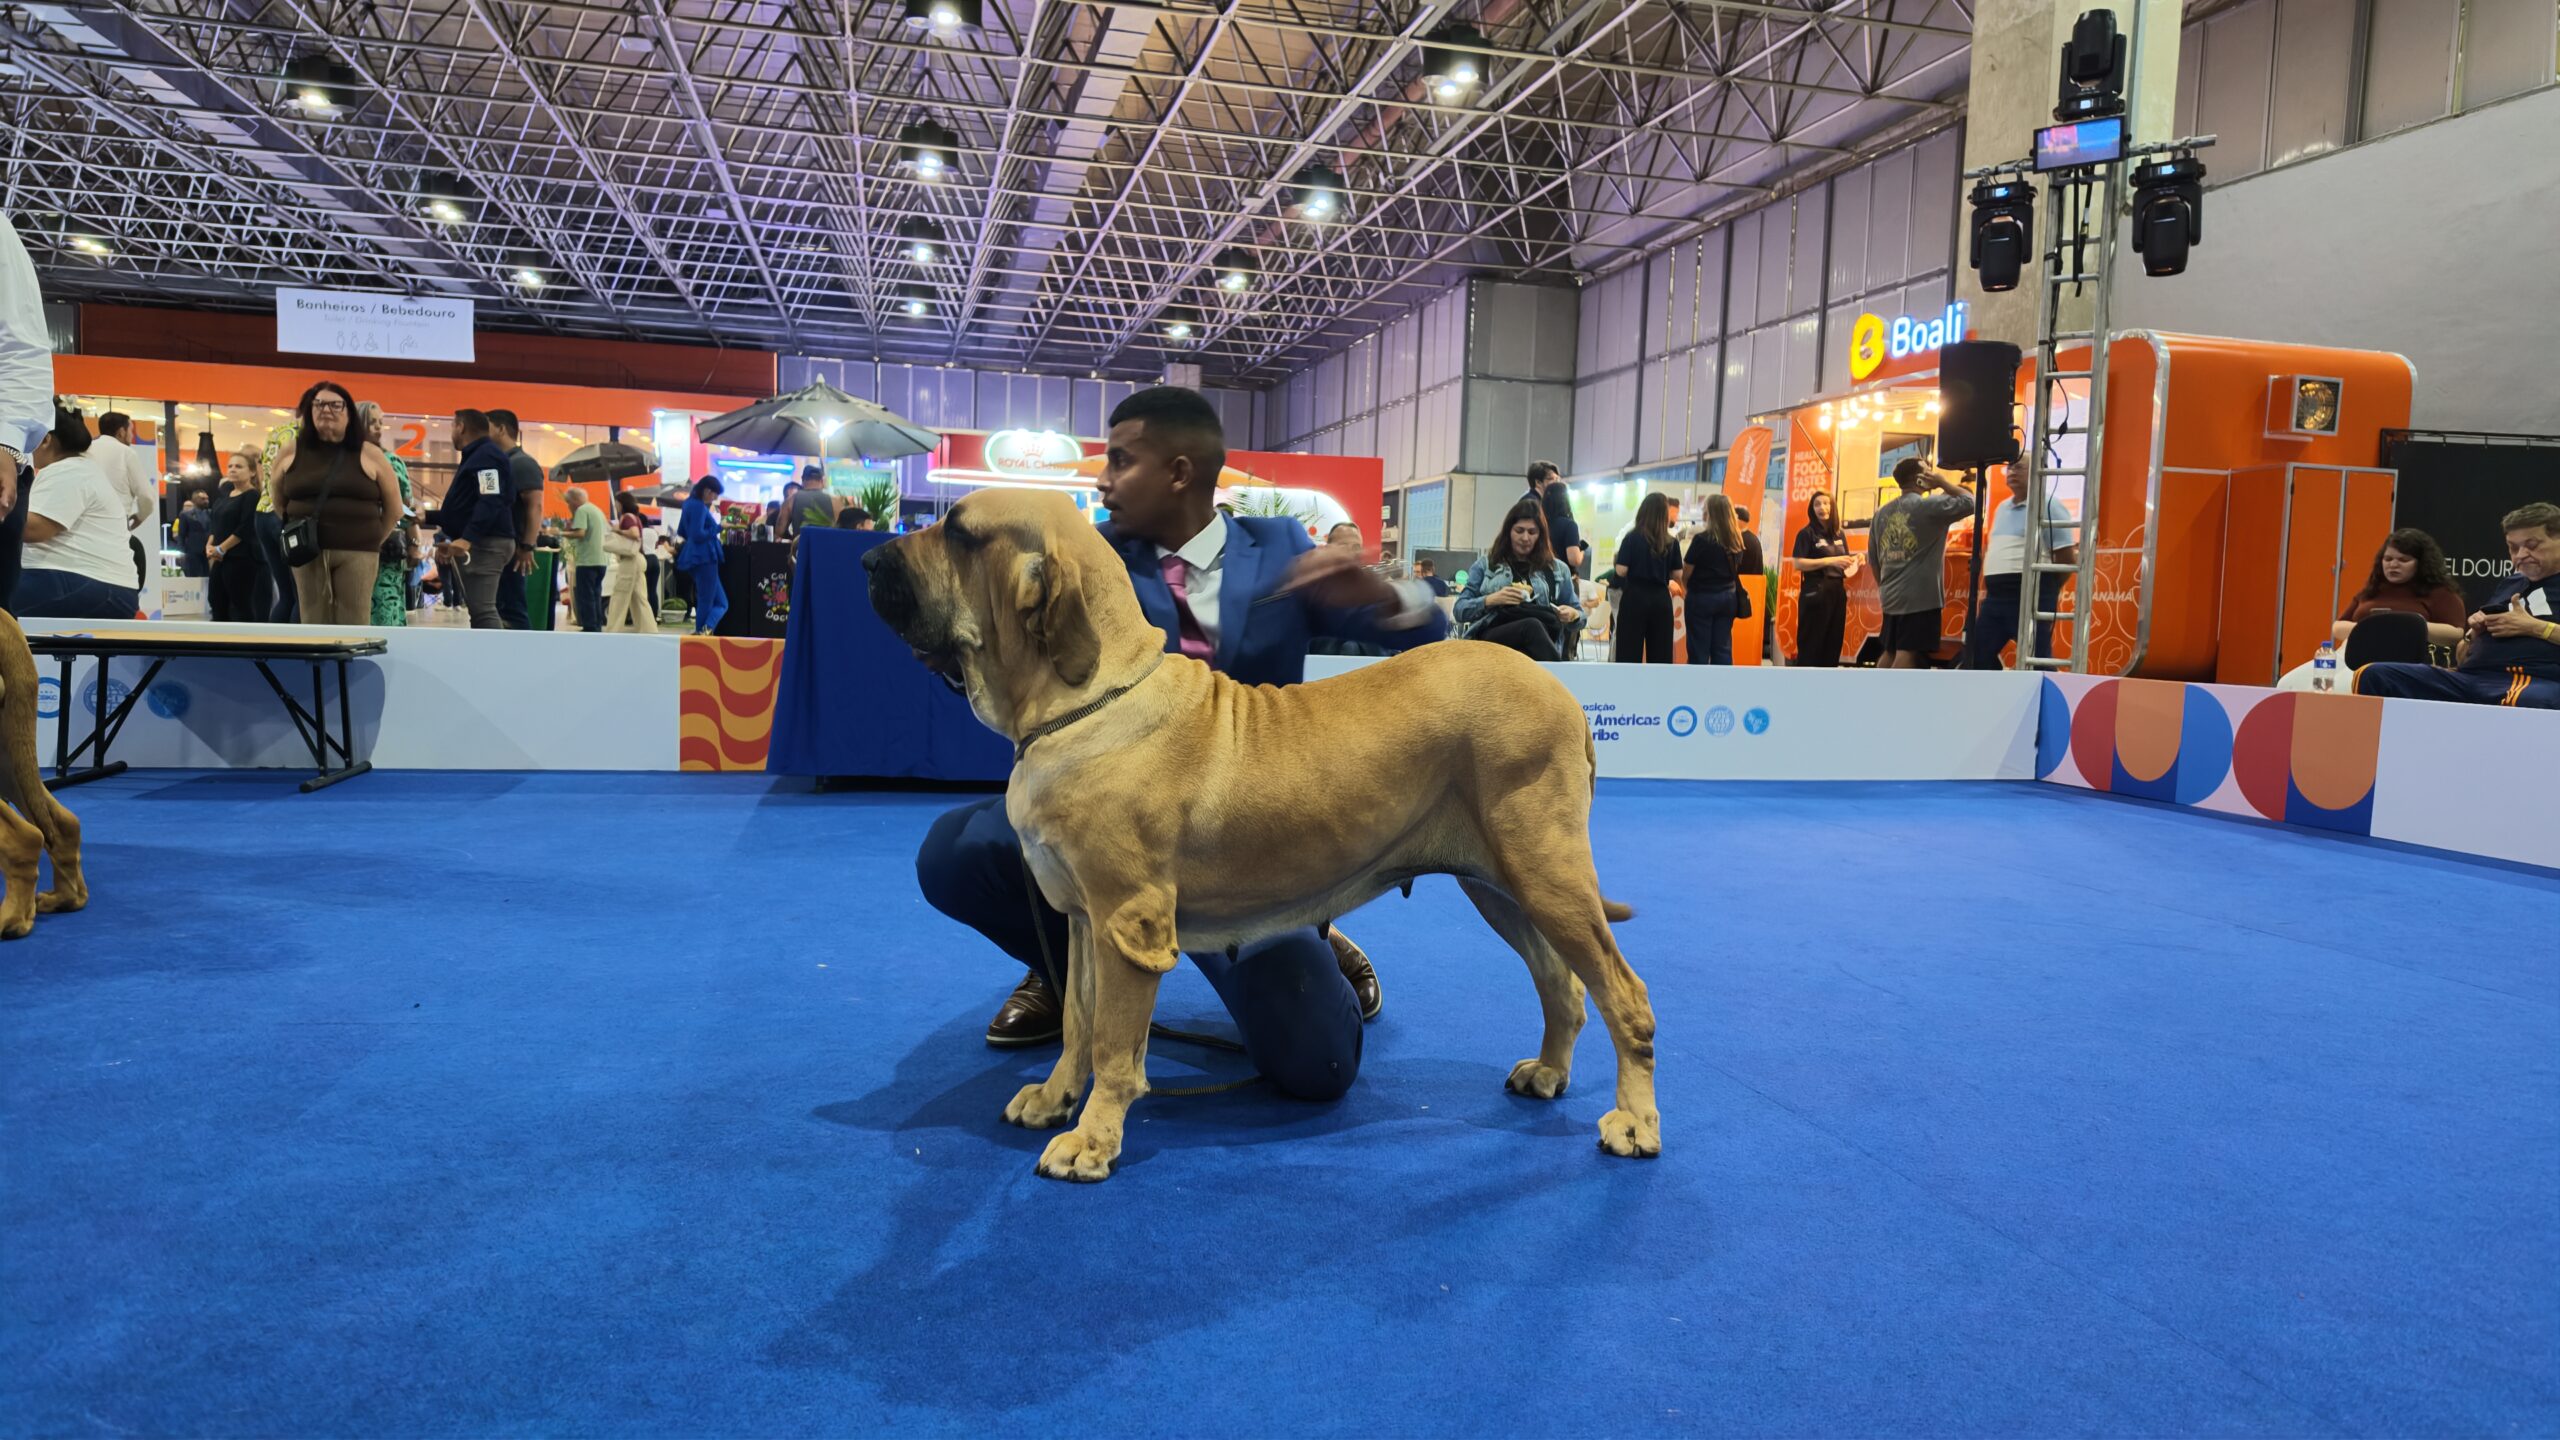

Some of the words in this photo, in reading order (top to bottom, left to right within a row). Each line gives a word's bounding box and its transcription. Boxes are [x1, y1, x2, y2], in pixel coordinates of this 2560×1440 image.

[297, 299, 366, 314] Banheiros
[382, 304, 456, 319] Bebedouro
[355, 317, 391, 328] Drinking
[394, 319, 431, 328] Fountain
[1892, 302, 1963, 358] Boali
[395, 423, 426, 457] 2
[998, 457, 1031, 469] ROYAL
[1793, 460, 1827, 476] FOOD
[1792, 474, 1827, 487] TASTES
[1583, 702, 1616, 712] osição
[1594, 713, 1661, 726] Américas
[1592, 729, 1620, 741] ribe
